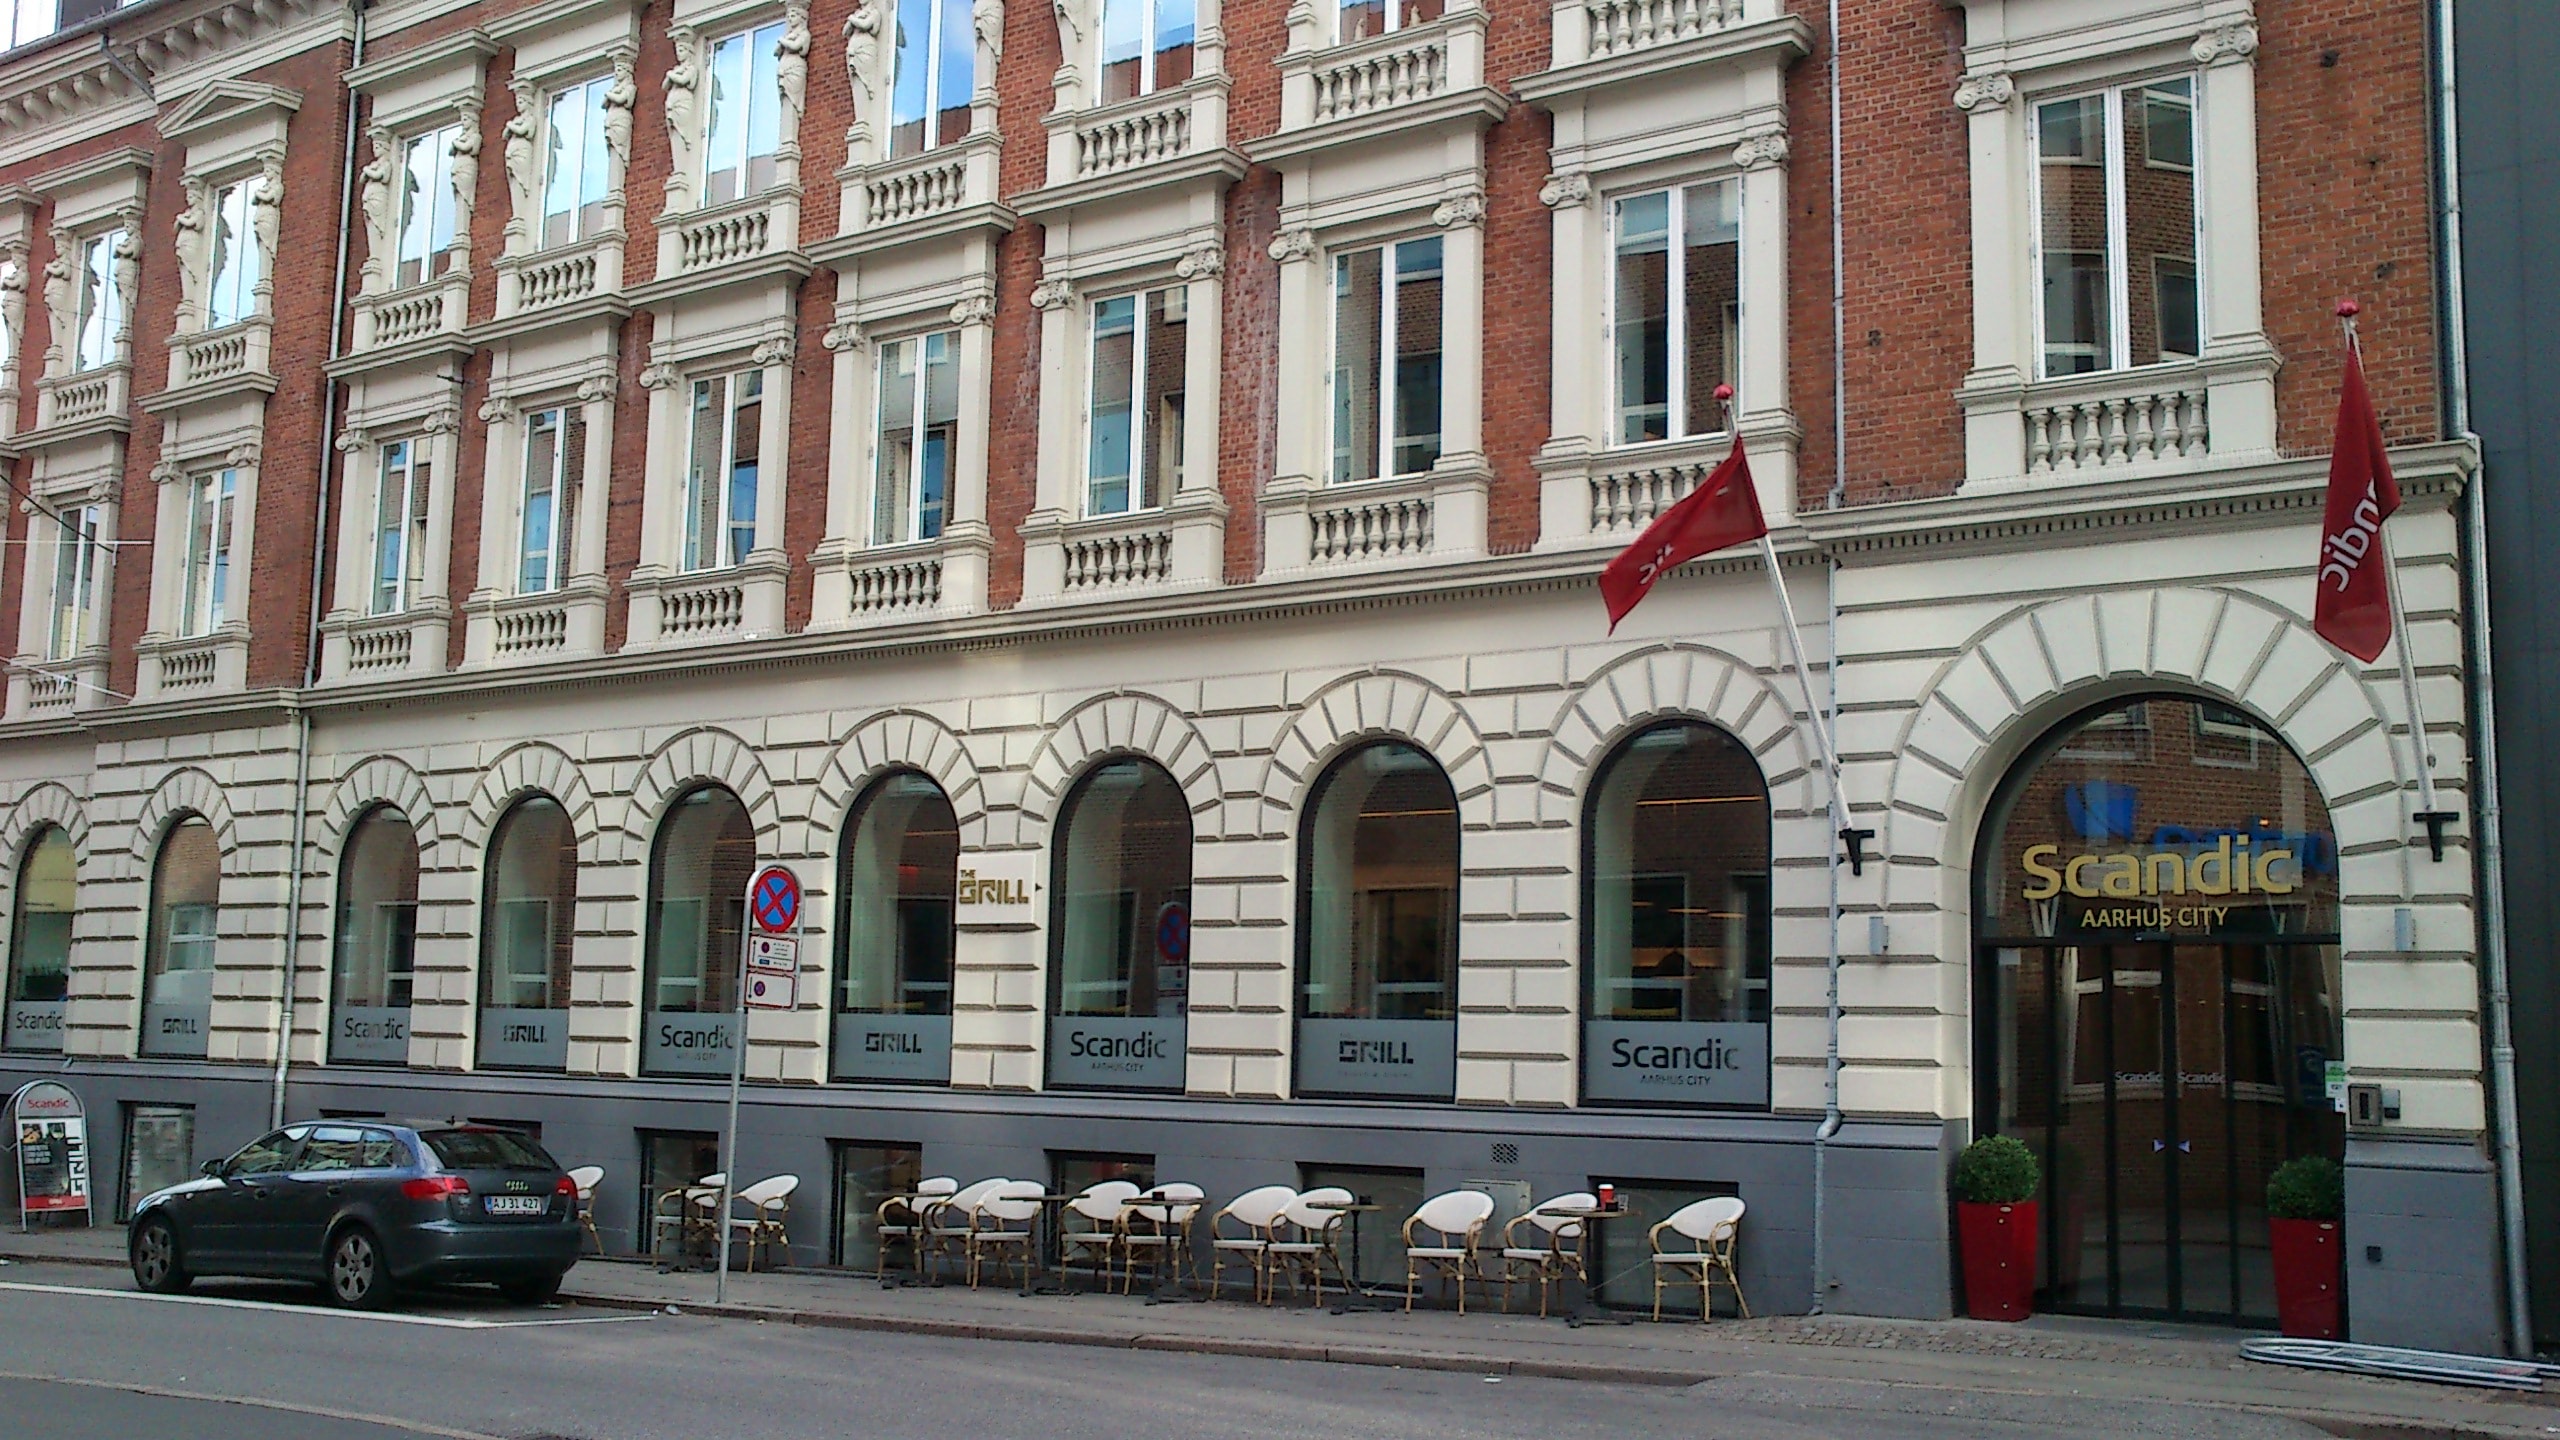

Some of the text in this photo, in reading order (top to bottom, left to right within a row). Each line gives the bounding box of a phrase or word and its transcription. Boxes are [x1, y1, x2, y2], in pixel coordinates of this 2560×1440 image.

[2022, 834, 2293, 900] Scandic
[959, 879, 1029, 905] GRILL
[2081, 907, 2229, 928] AARHUS CITY
[15, 1011, 63, 1030] Scandic
[162, 1018, 197, 1034] GRILL
[344, 1016, 403, 1040] Scandic
[503, 1024, 547, 1043] GRILL
[660, 1025, 734, 1049] Scandic
[865, 1032, 922, 1053] GRILL
[1070, 1031, 1167, 1058] Scandic
[1339, 1040, 1414, 1064] GRILL
[1611, 1038, 1739, 1071] Scandic
[1687, 1074, 1711, 1086] CITY
[27, 1098, 69, 1109] Scandic
[493, 1197, 539, 1209] AJ 31 427
